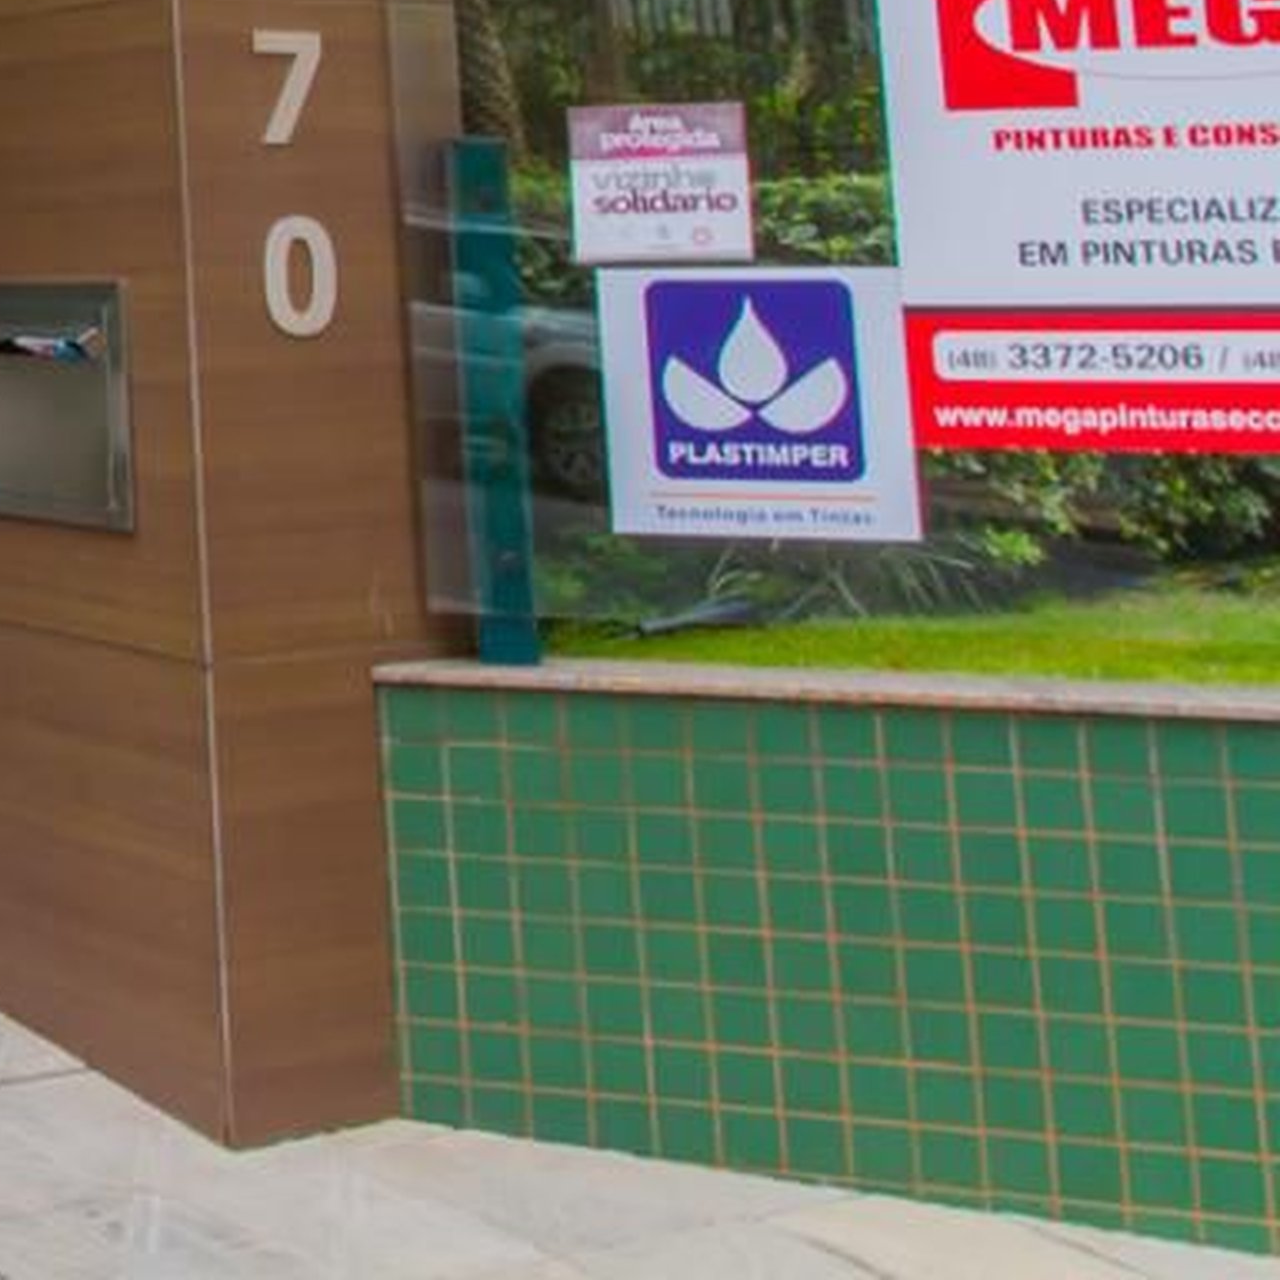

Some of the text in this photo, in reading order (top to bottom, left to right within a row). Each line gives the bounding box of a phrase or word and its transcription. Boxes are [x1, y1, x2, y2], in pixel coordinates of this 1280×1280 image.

[993, 123, 1280, 151] PINTURAS E CONS
[1081, 197, 1278, 225] ESPECIALIZ
[1018, 241, 1069, 267] EM
[1081, 238, 1259, 265] PINTURAS
[1007, 342, 1204, 371] 3372-5206
[667, 440, 850, 468] PLASTIMPER
